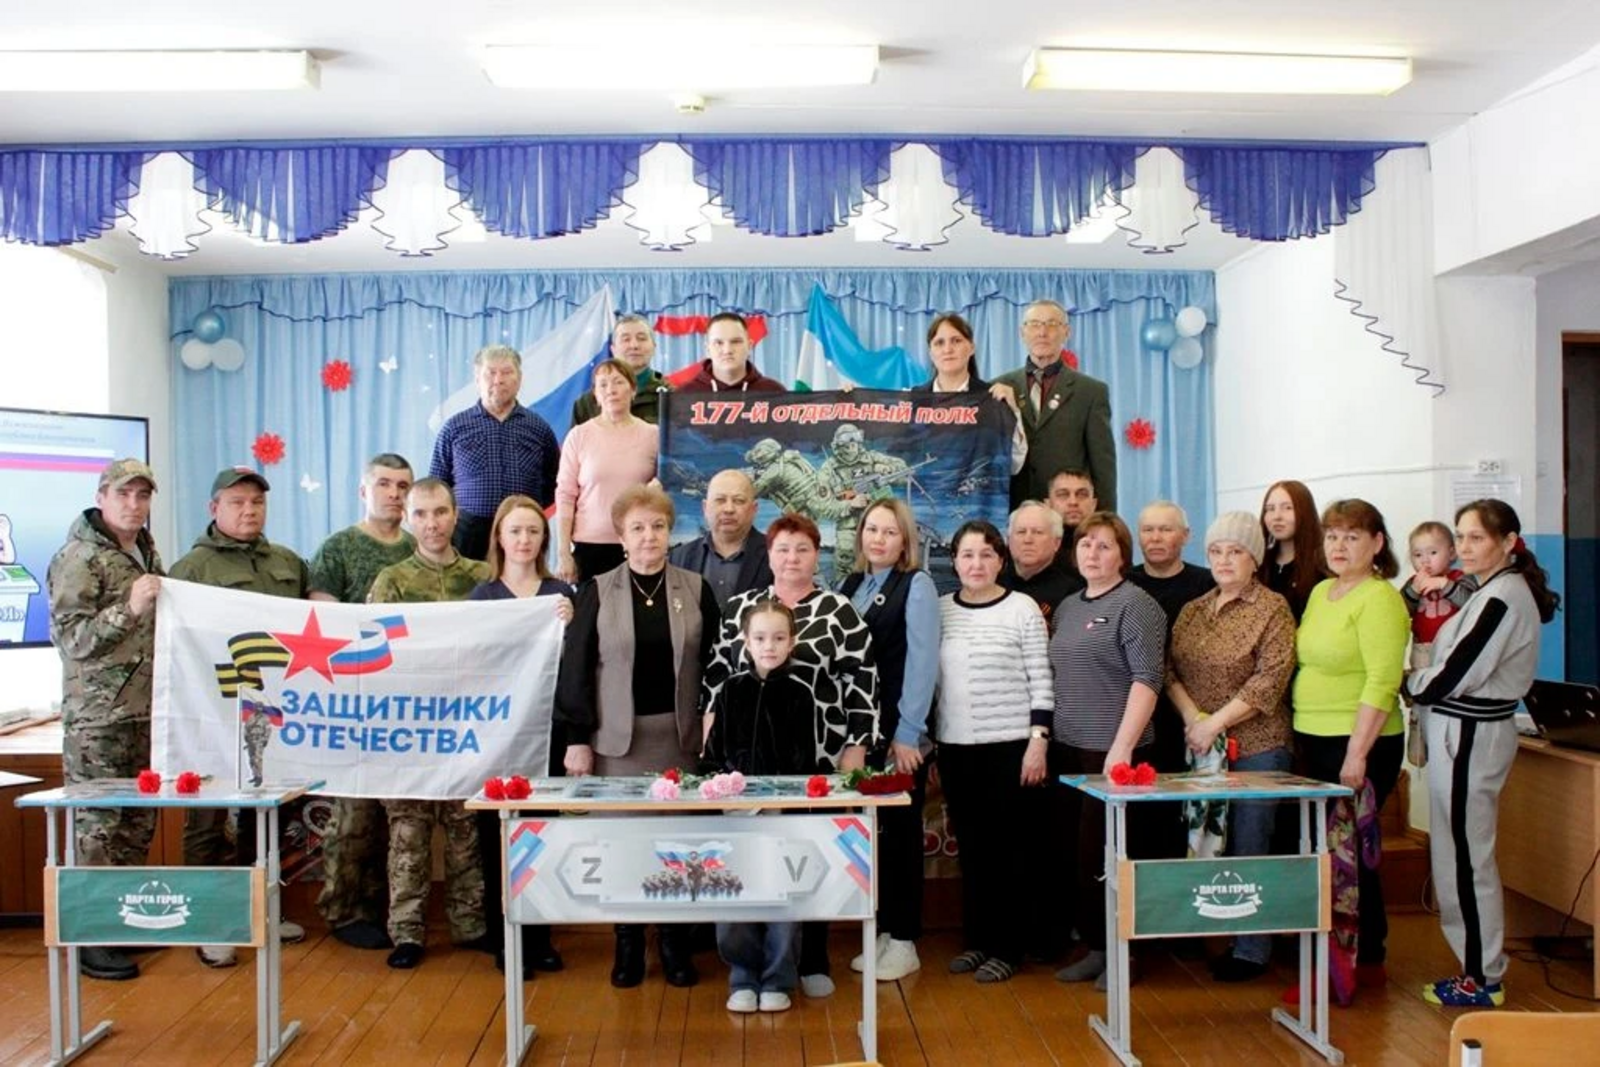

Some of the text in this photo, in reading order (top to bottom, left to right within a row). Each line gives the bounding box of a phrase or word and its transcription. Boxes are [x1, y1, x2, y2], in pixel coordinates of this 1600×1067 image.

[915, 406, 979, 424] ПОЛК
[281, 689, 511, 722] ЗАЩИТНИКИ
[280, 721, 480, 754] ОТЕЧЕСТВА
[582, 857, 602, 884] Z
[783, 855, 808, 882] V
